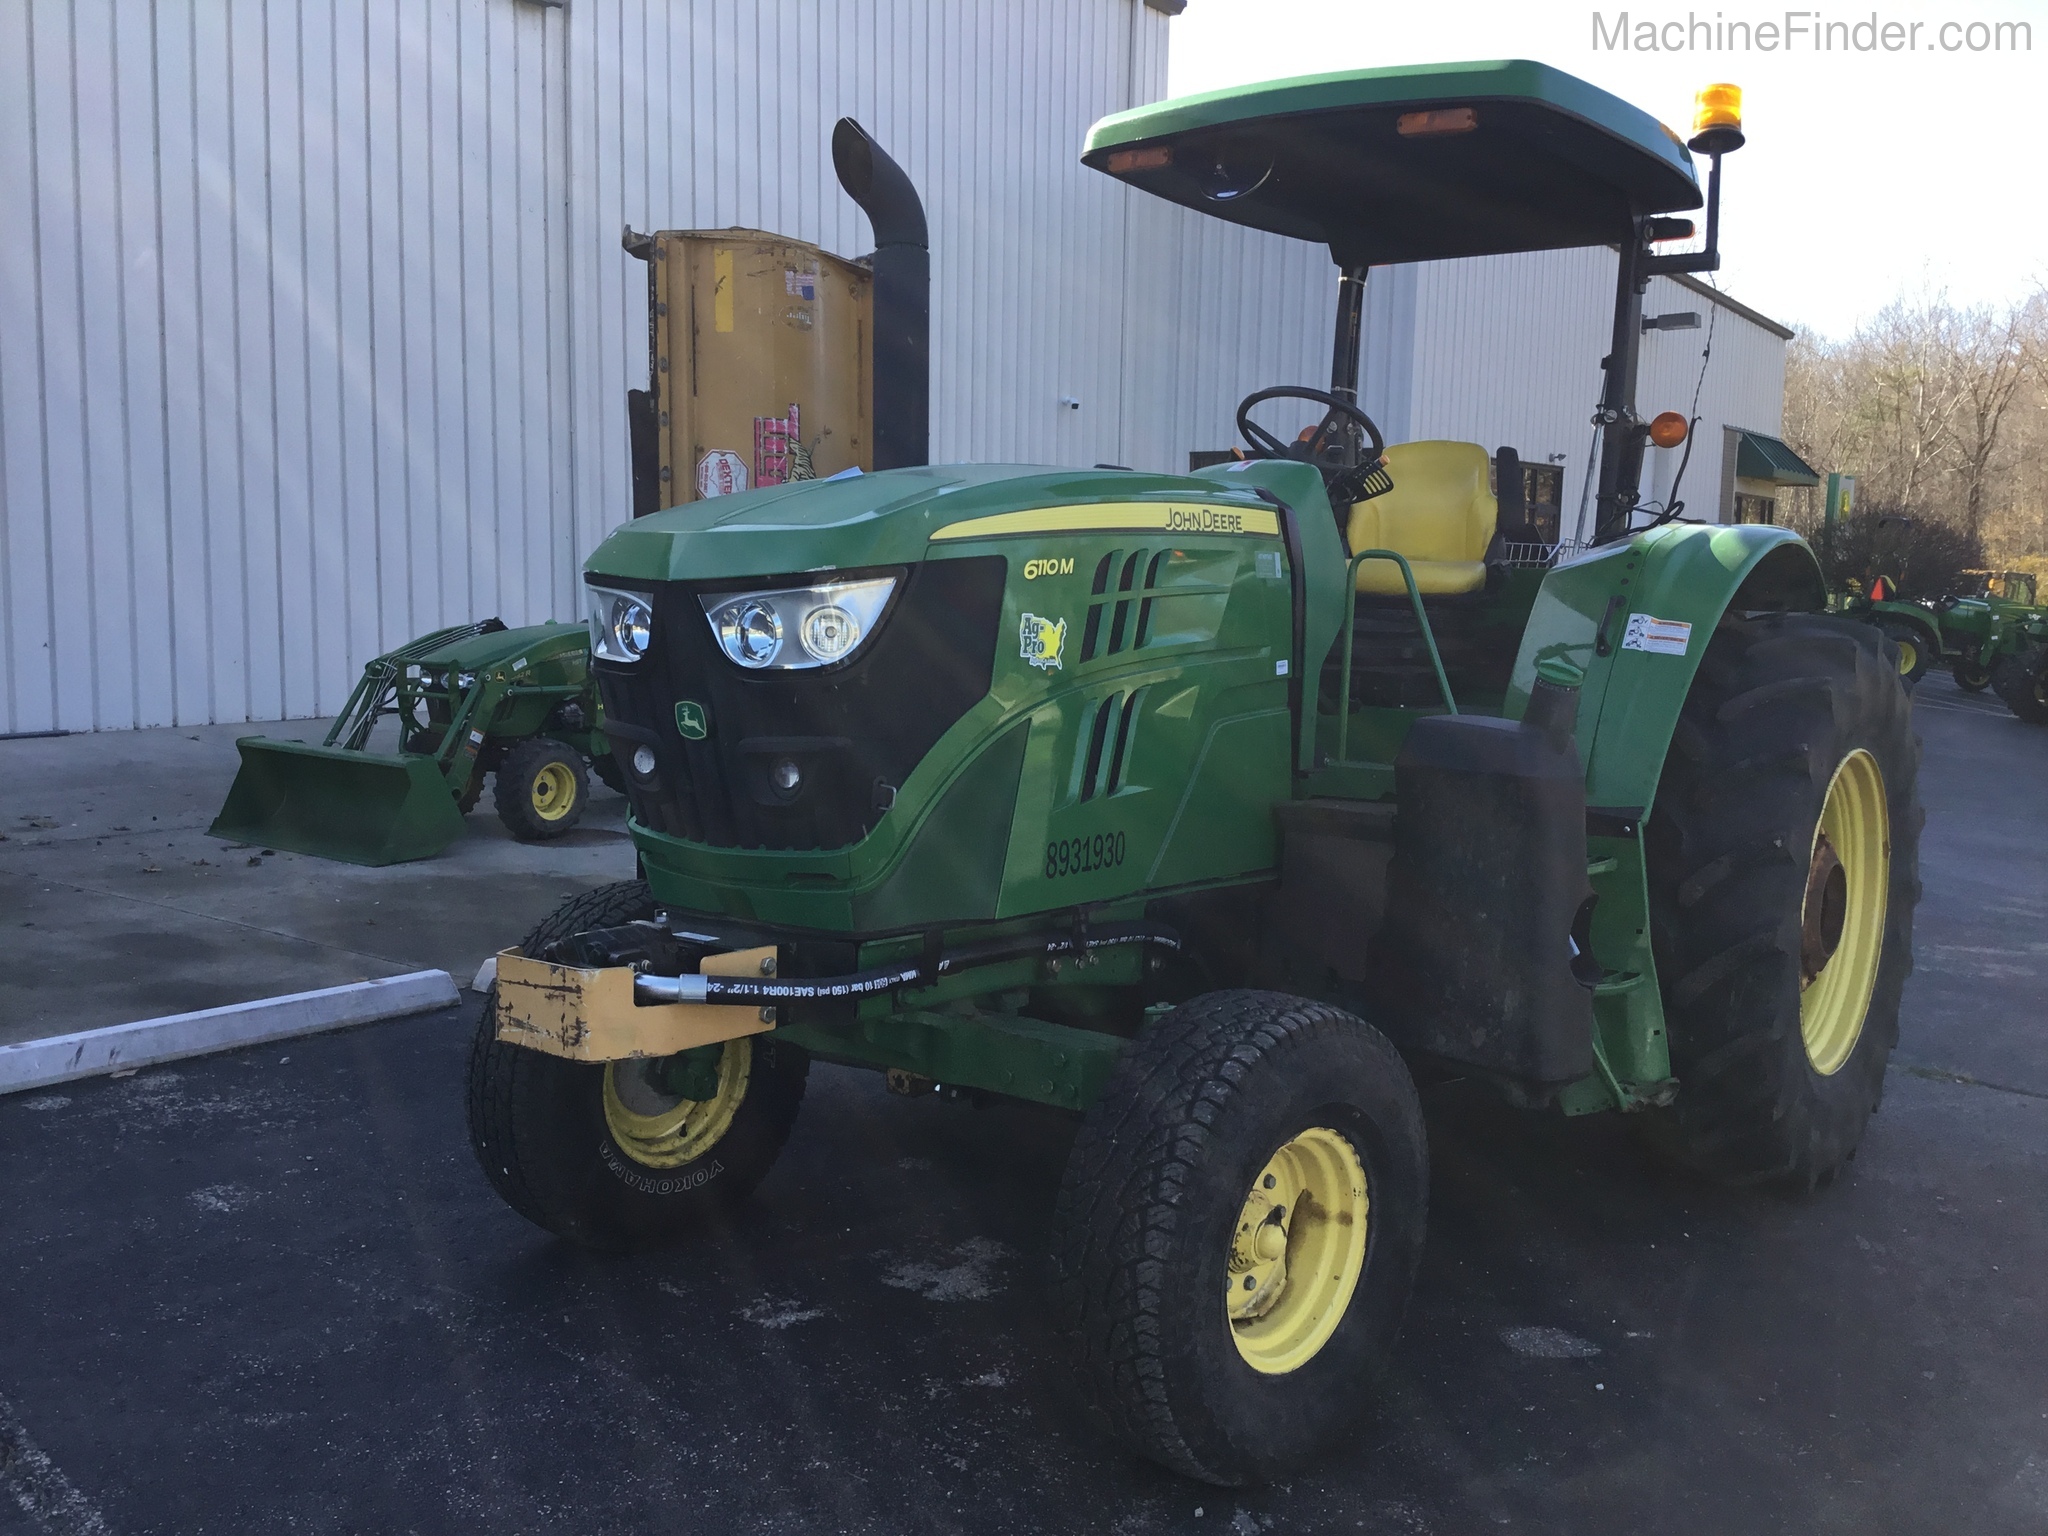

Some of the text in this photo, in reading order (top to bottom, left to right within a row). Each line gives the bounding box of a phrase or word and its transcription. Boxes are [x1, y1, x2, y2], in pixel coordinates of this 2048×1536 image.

[1165, 507, 1244, 532] JOHN DEERE
[1022, 635, 1045, 654] Pro
[1045, 830, 1126, 880] 8931930
[707, 981, 724, 994] -24
[763, 985, 814, 998] SAE100R4
[817, 986, 831, 998] psi)
[832, 984, 850, 996] (150
[850, 982, 864, 993] bar
[598, 1140, 725, 1195] YOKOHAMA
